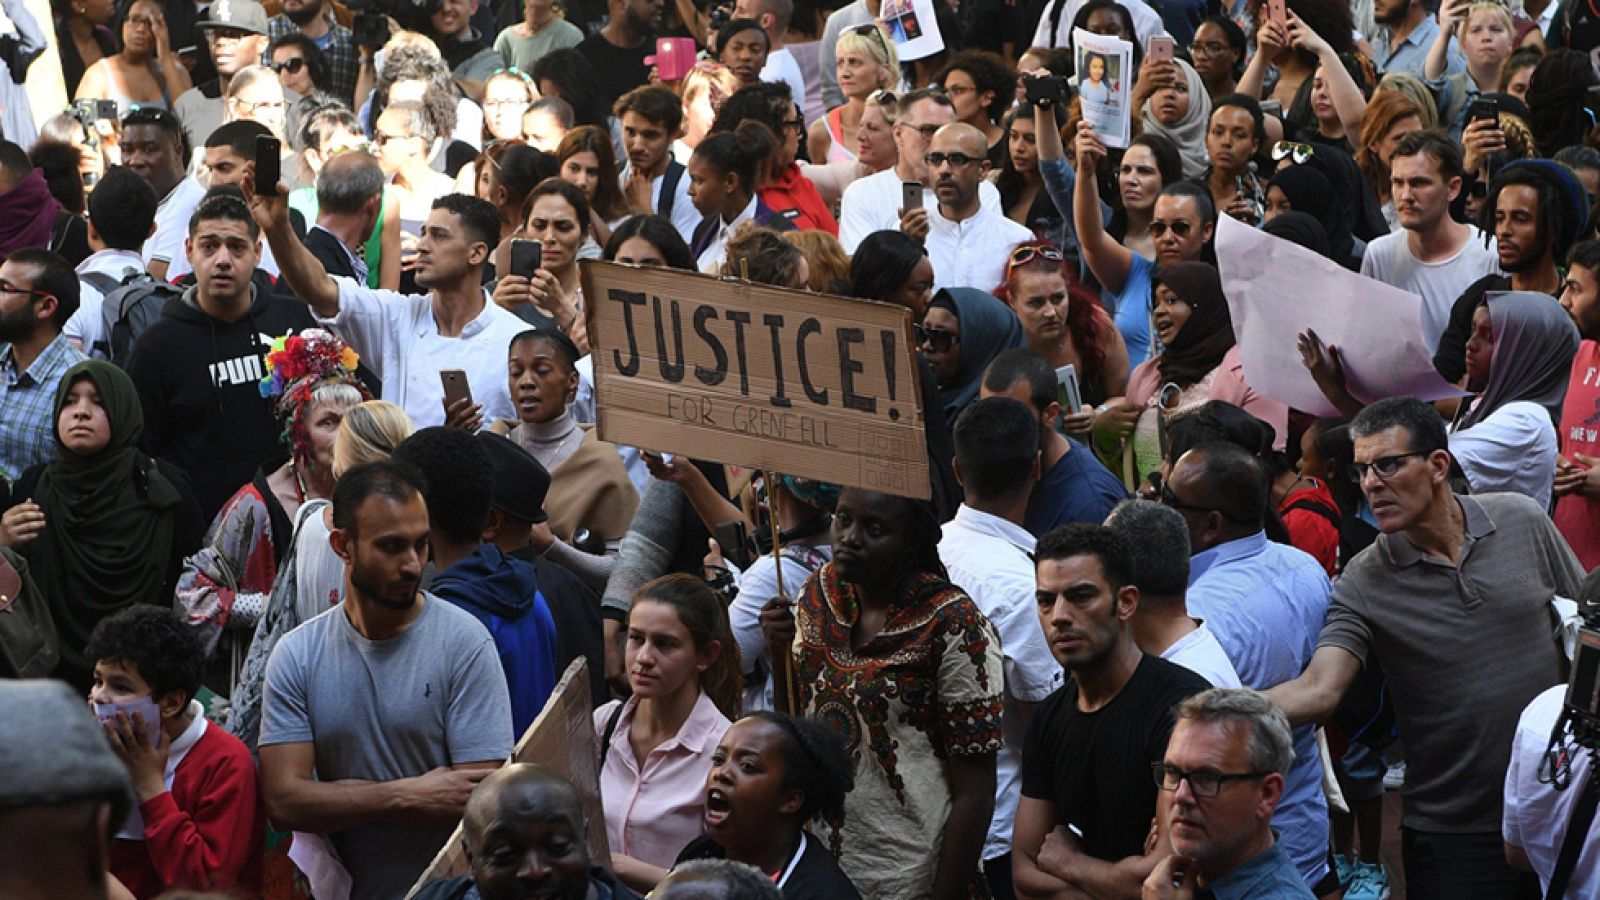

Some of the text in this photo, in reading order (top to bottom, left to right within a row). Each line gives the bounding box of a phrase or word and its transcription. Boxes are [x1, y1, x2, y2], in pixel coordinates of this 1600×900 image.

[608, 288, 900, 420] JUSTICE!
[667, 392, 838, 448] FOR GRENFELL
